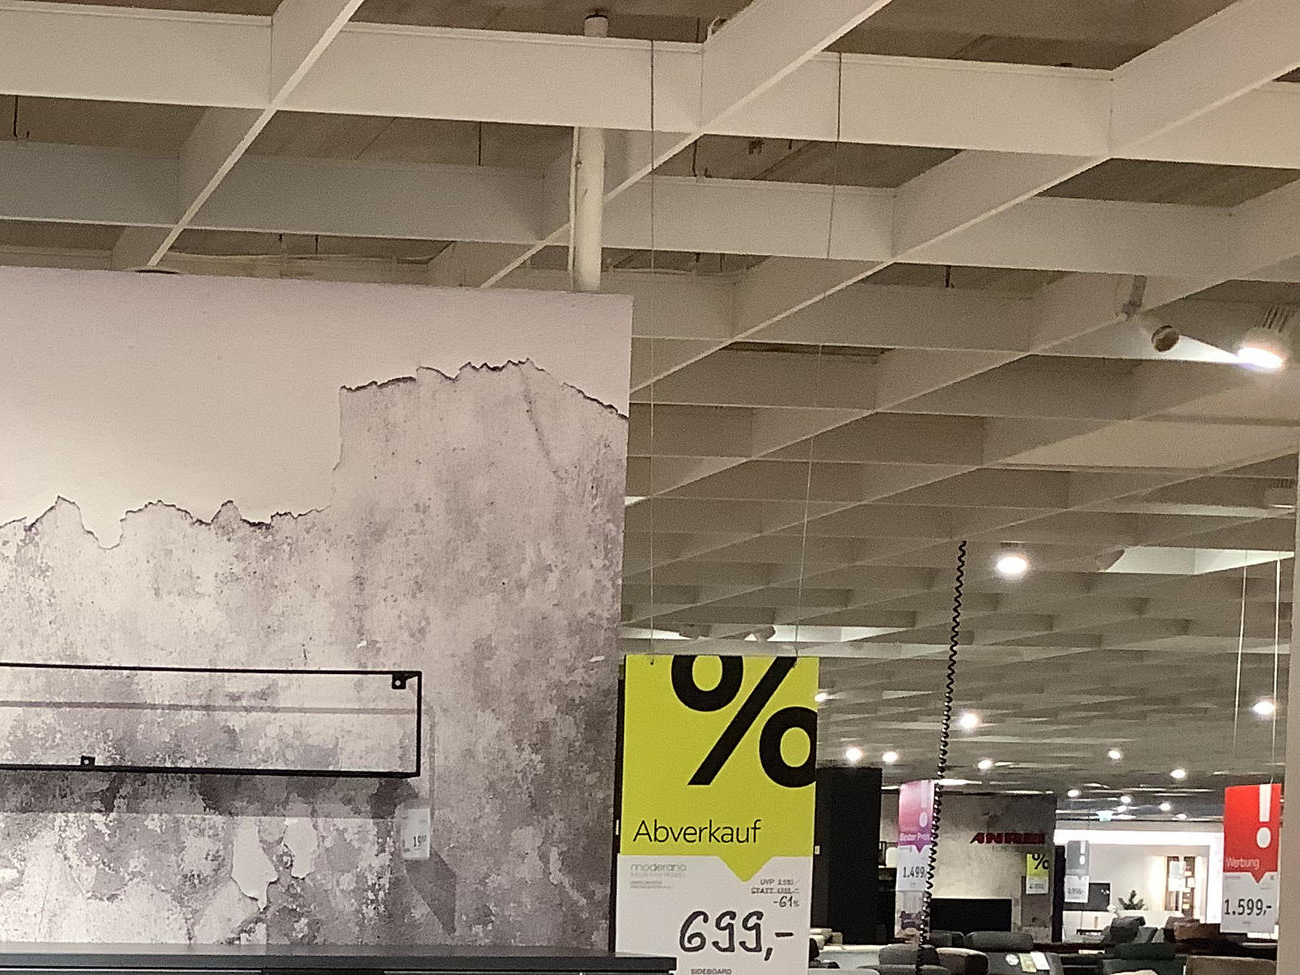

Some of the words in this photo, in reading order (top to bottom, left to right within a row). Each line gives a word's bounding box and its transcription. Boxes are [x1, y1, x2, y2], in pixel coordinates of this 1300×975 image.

[632, 819, 762, 844] Abverkauf
[1226, 857, 1260, 870] Werbung
[1224, 898, 1272, 916] 1.599,-
[679, 910, 794, 961] 699,-
